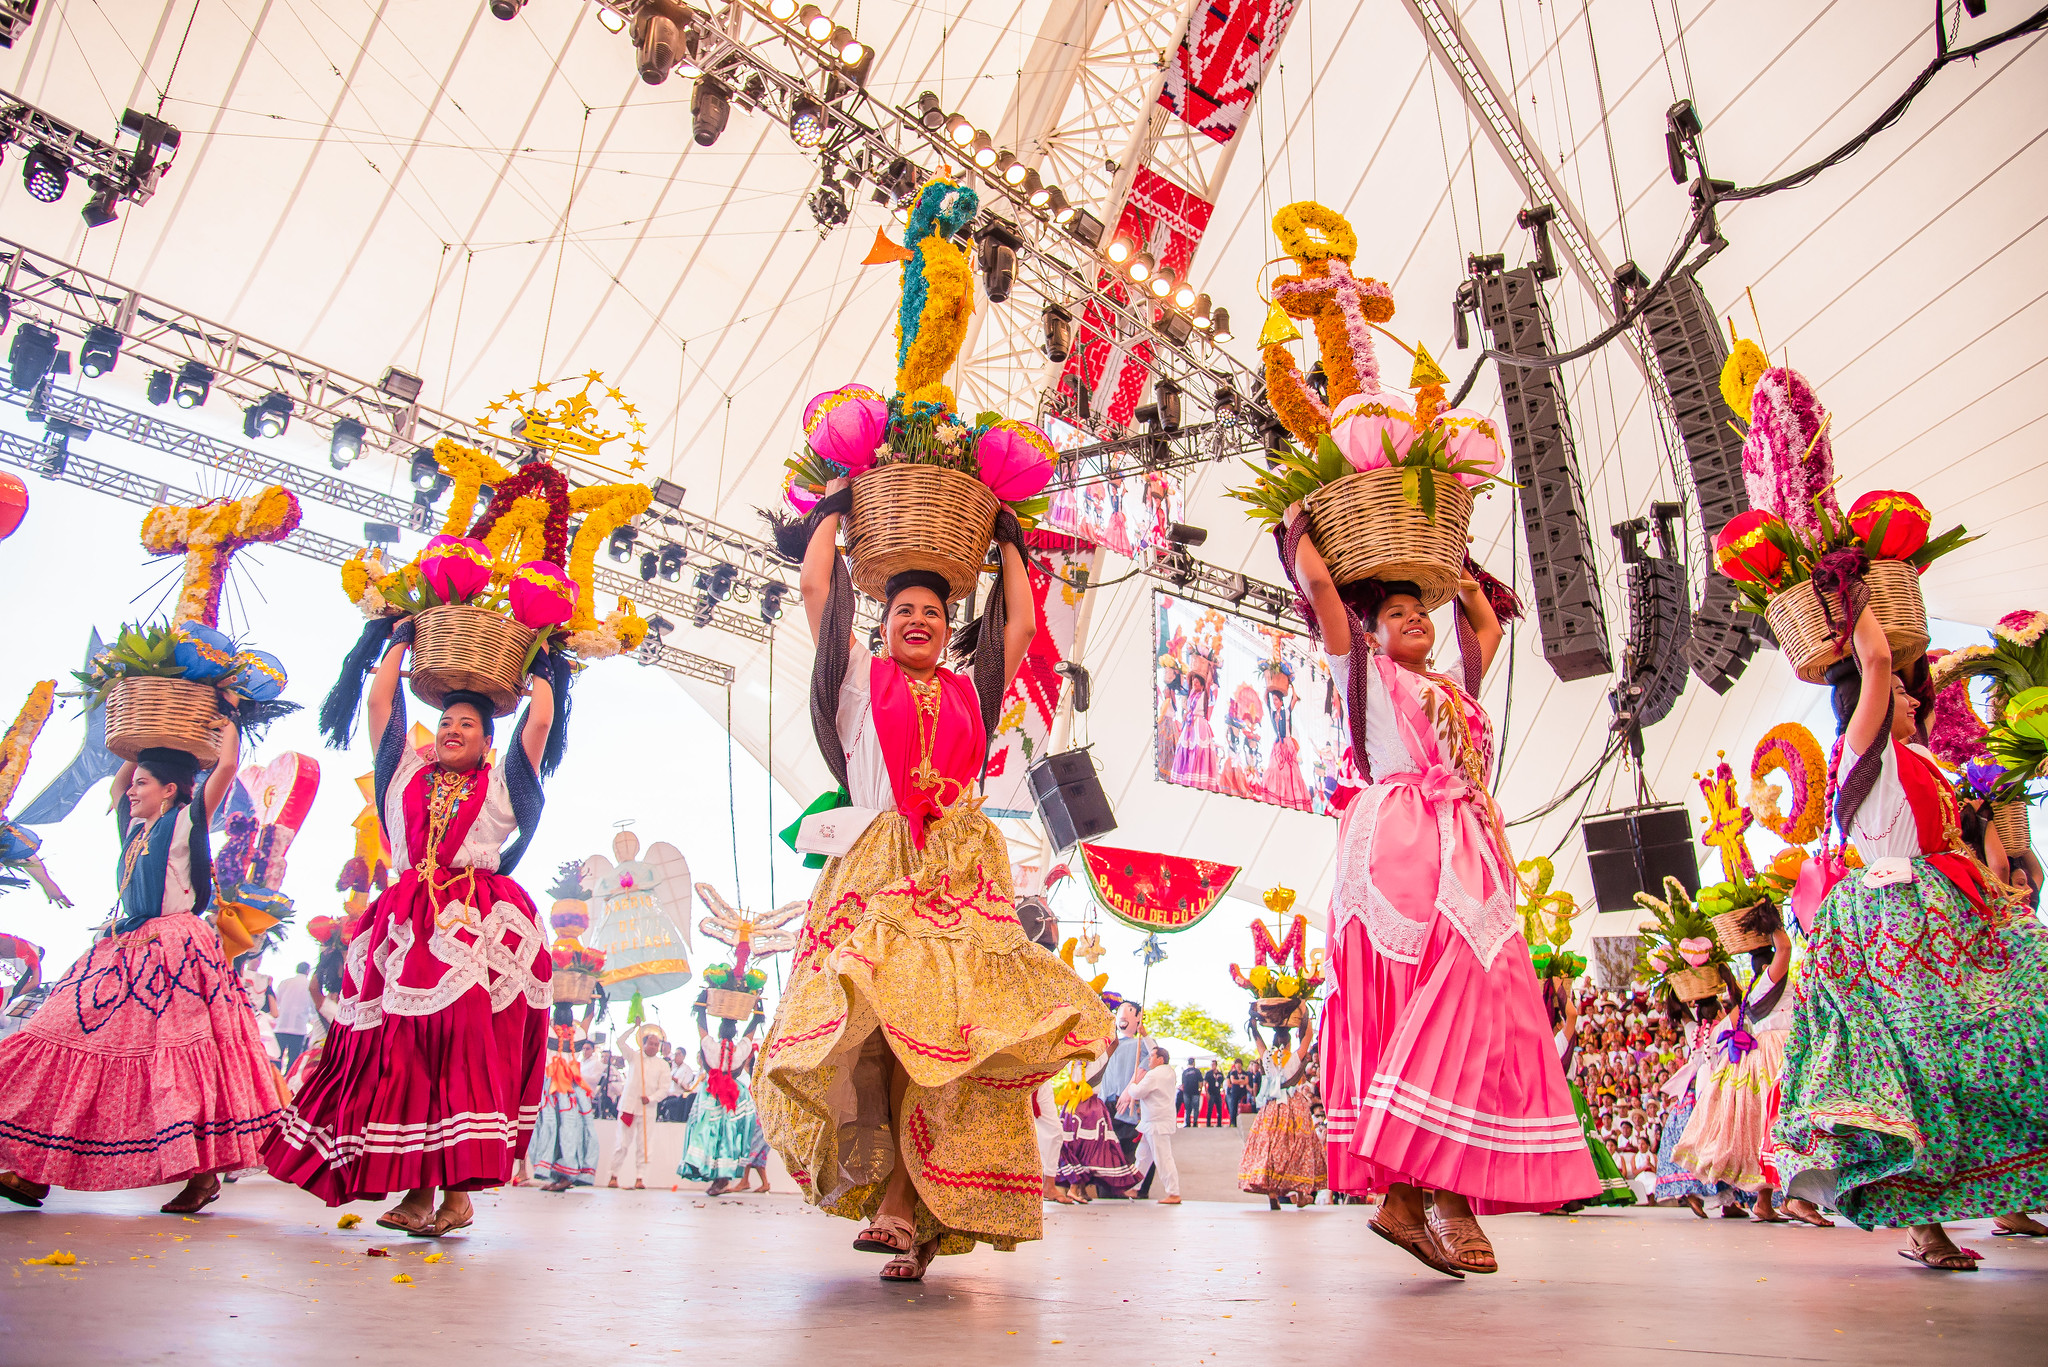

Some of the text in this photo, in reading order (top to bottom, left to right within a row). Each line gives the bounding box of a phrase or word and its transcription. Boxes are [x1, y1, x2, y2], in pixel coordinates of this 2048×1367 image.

[1099, 874, 1215, 925] BARRIO DEL POLVO
[618, 918, 637, 933] DE
